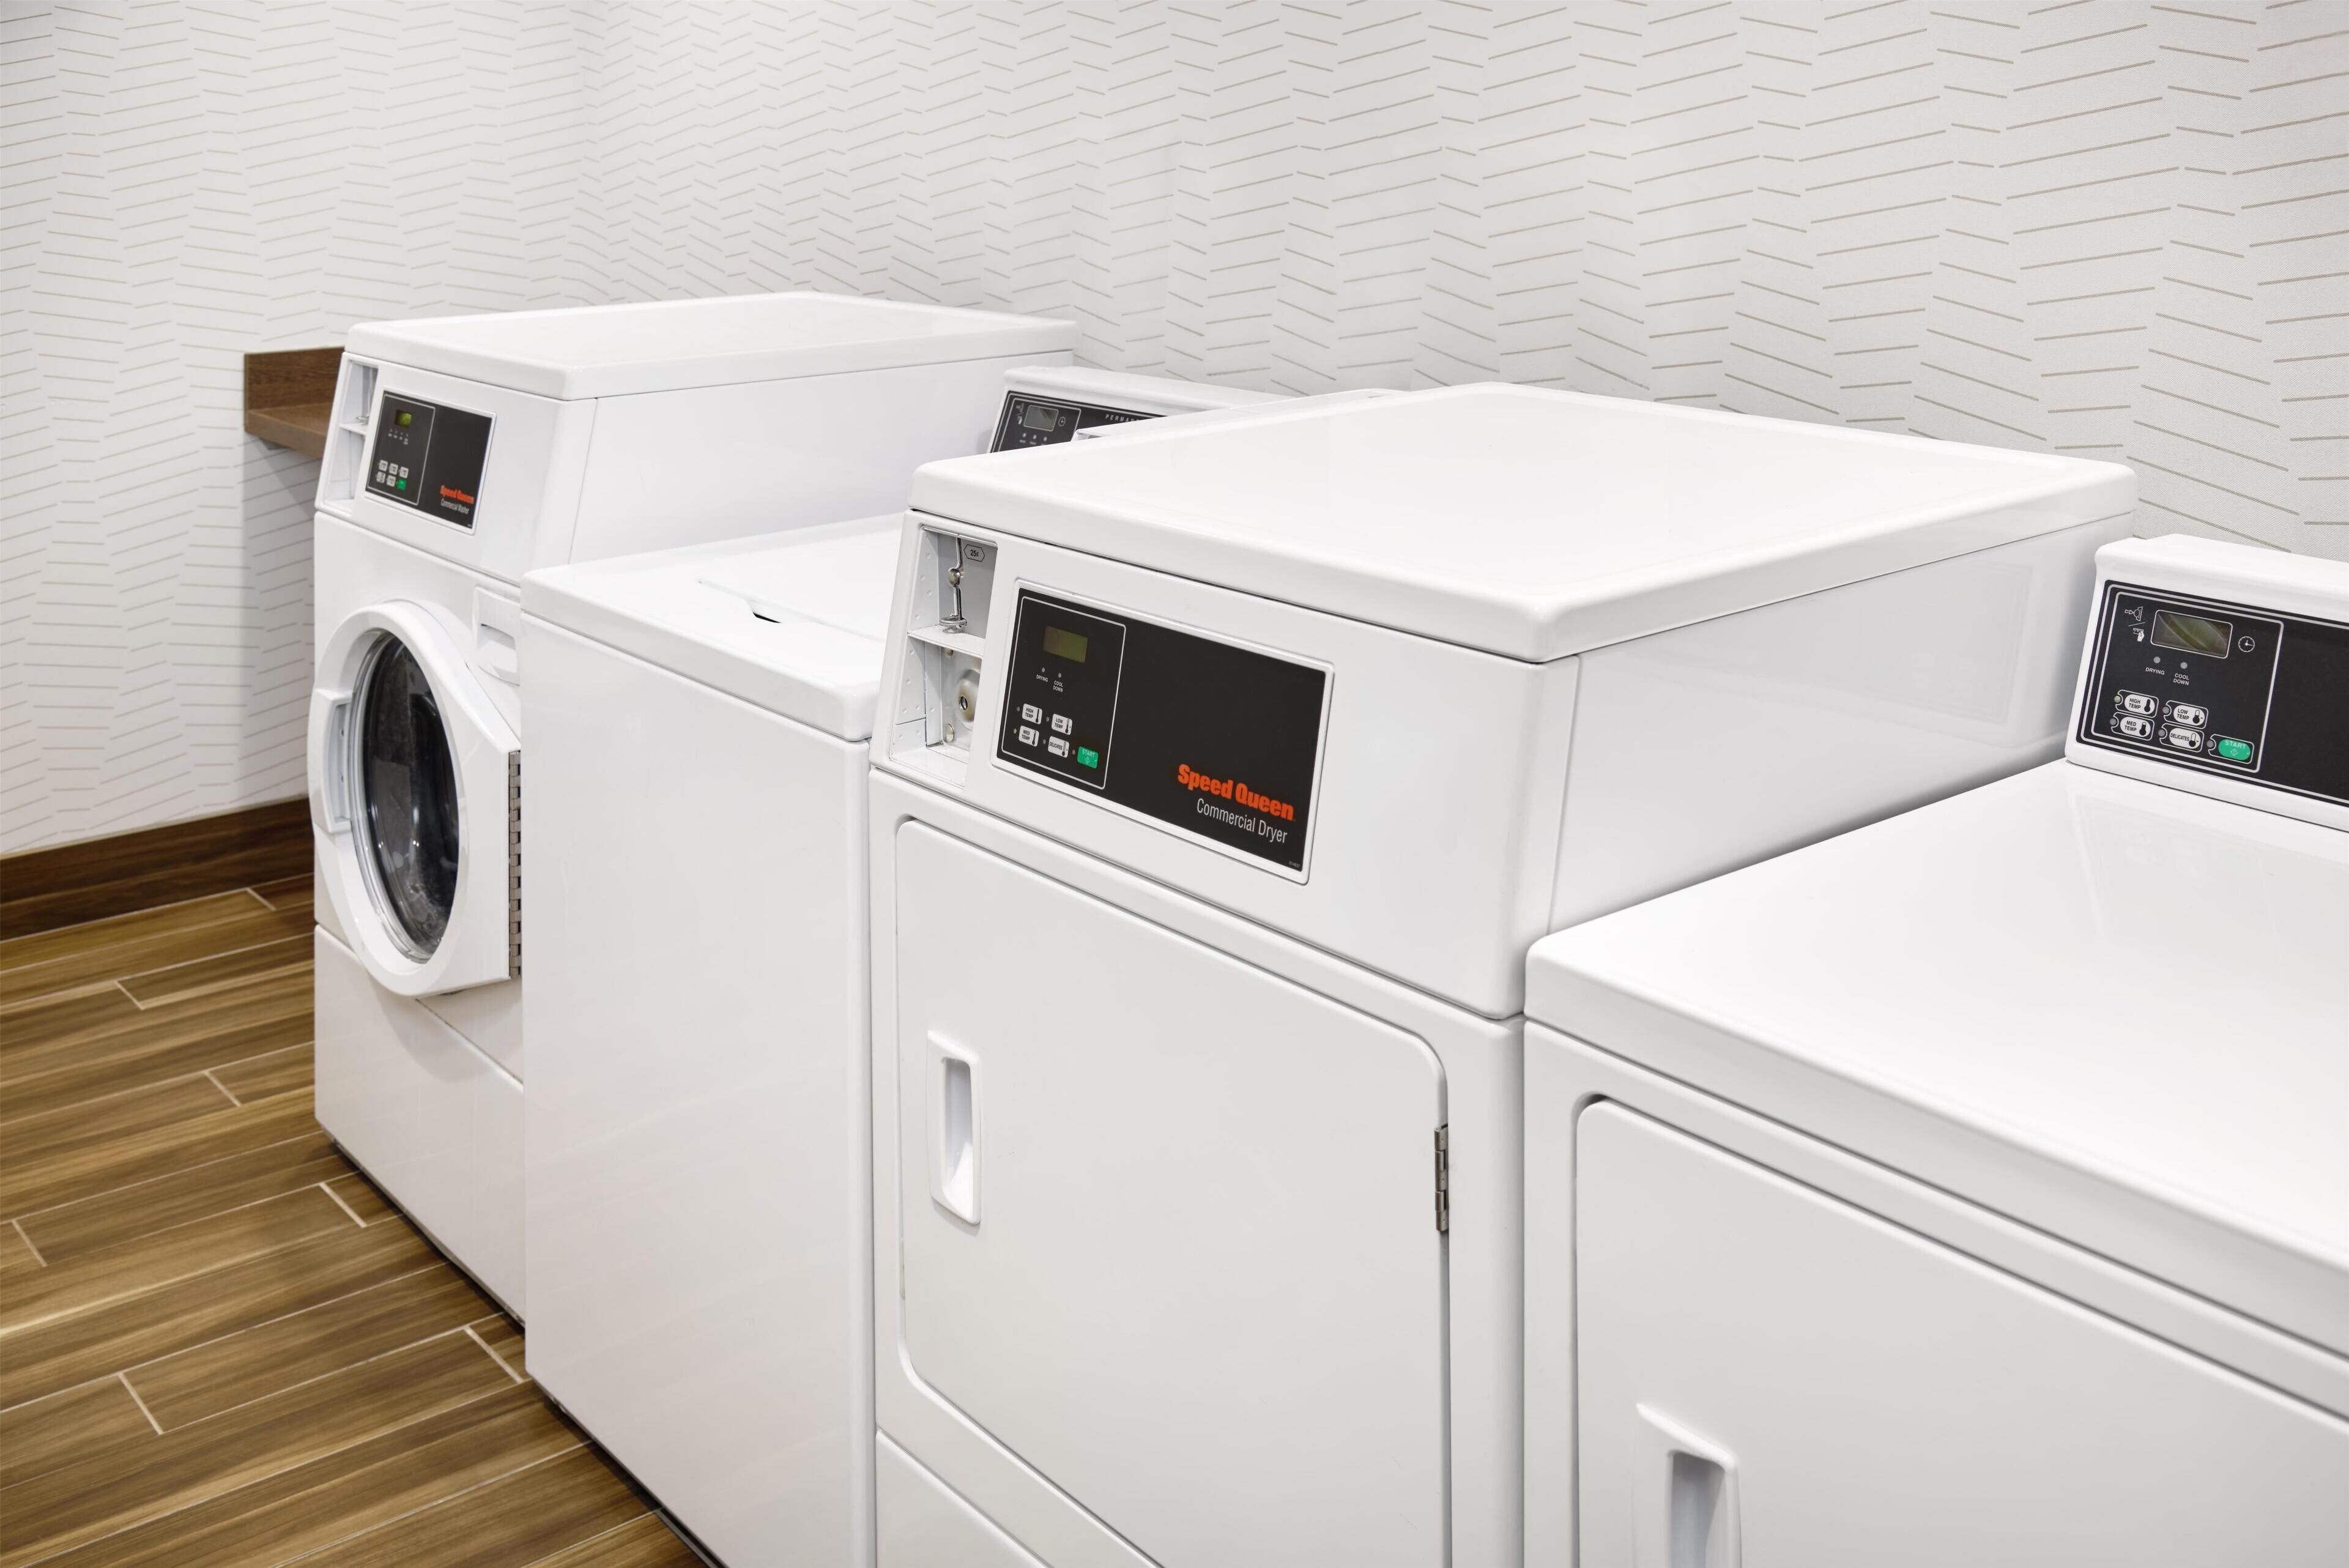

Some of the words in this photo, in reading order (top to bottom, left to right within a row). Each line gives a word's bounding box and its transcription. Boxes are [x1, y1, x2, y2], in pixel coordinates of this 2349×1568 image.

[440, 485, 456, 498] Speed
[457, 489, 475, 505] Queen
[2145, 667, 2165, 675] DRYING
[1036, 674, 1048, 683] DRYING
[2170, 733, 2190, 742] DELICATES
[1049, 741, 1063, 750] DELICATES
[2225, 740, 2247, 749] START
[1082, 748, 1096, 757] START
[1178, 764, 1234, 799] Speed
[1235, 782, 1294, 821] Queen
[1197, 798, 1256, 833] Commercial
[1258, 819, 1288, 844] Dryer
